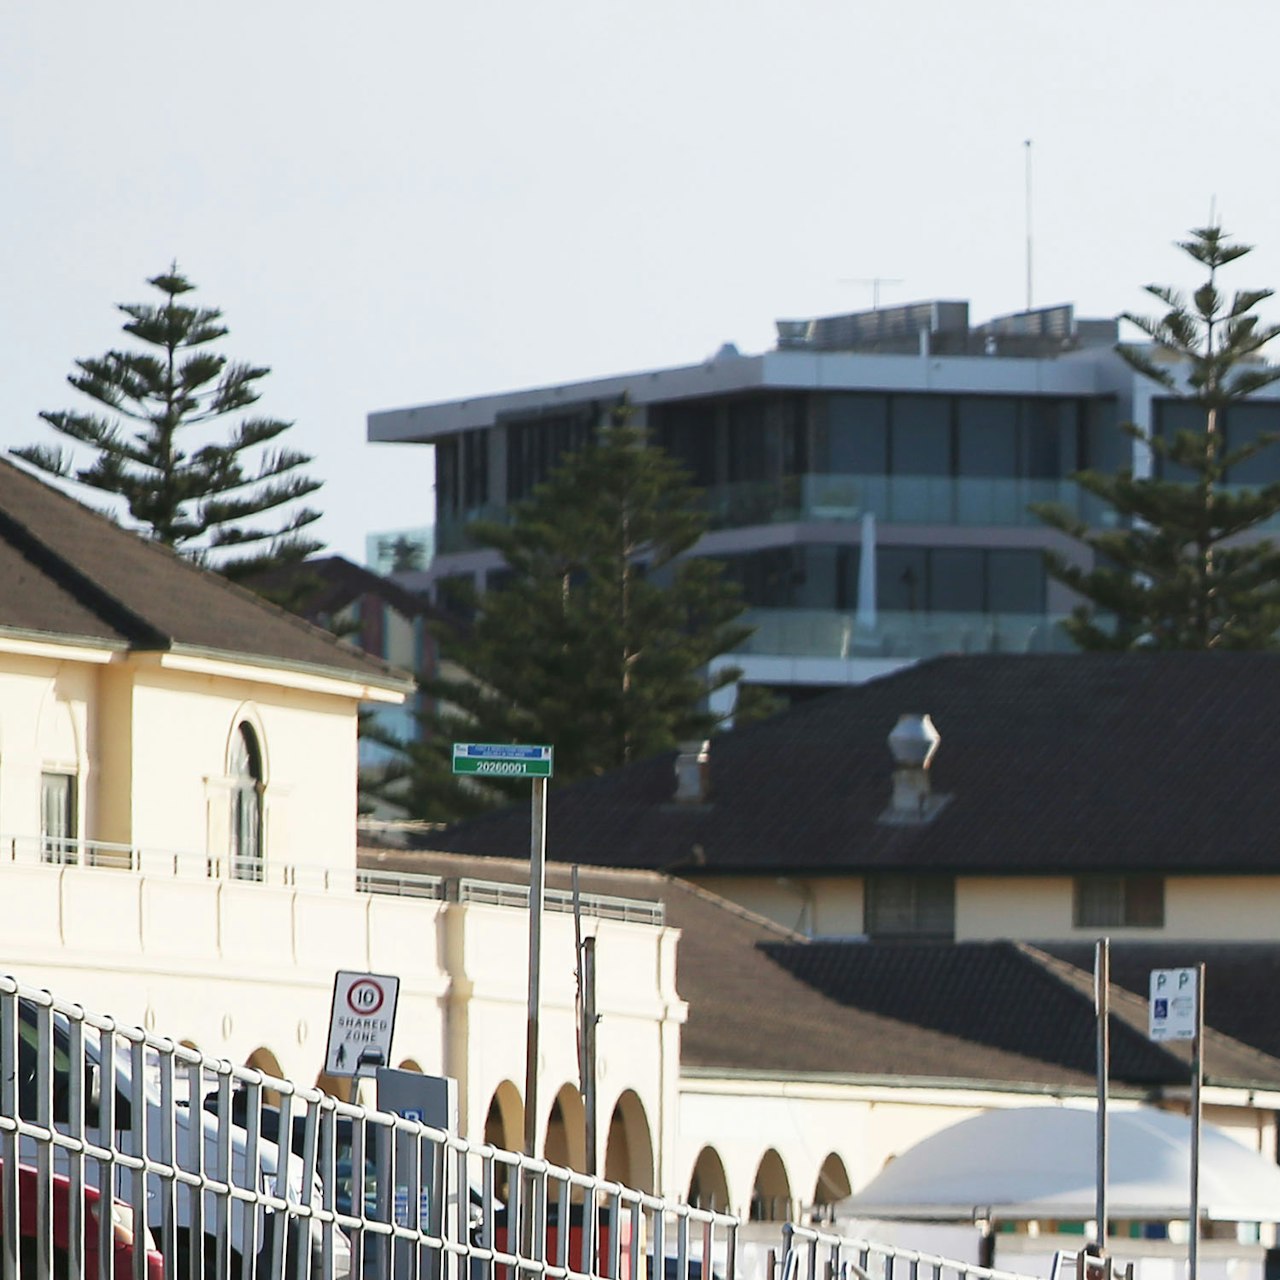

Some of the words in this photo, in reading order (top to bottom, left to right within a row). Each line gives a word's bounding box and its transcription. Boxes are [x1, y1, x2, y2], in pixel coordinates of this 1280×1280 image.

[358, 988, 374, 1006] 10
[338, 1016, 387, 1032] SHARED
[345, 1029, 376, 1043] ZONE
